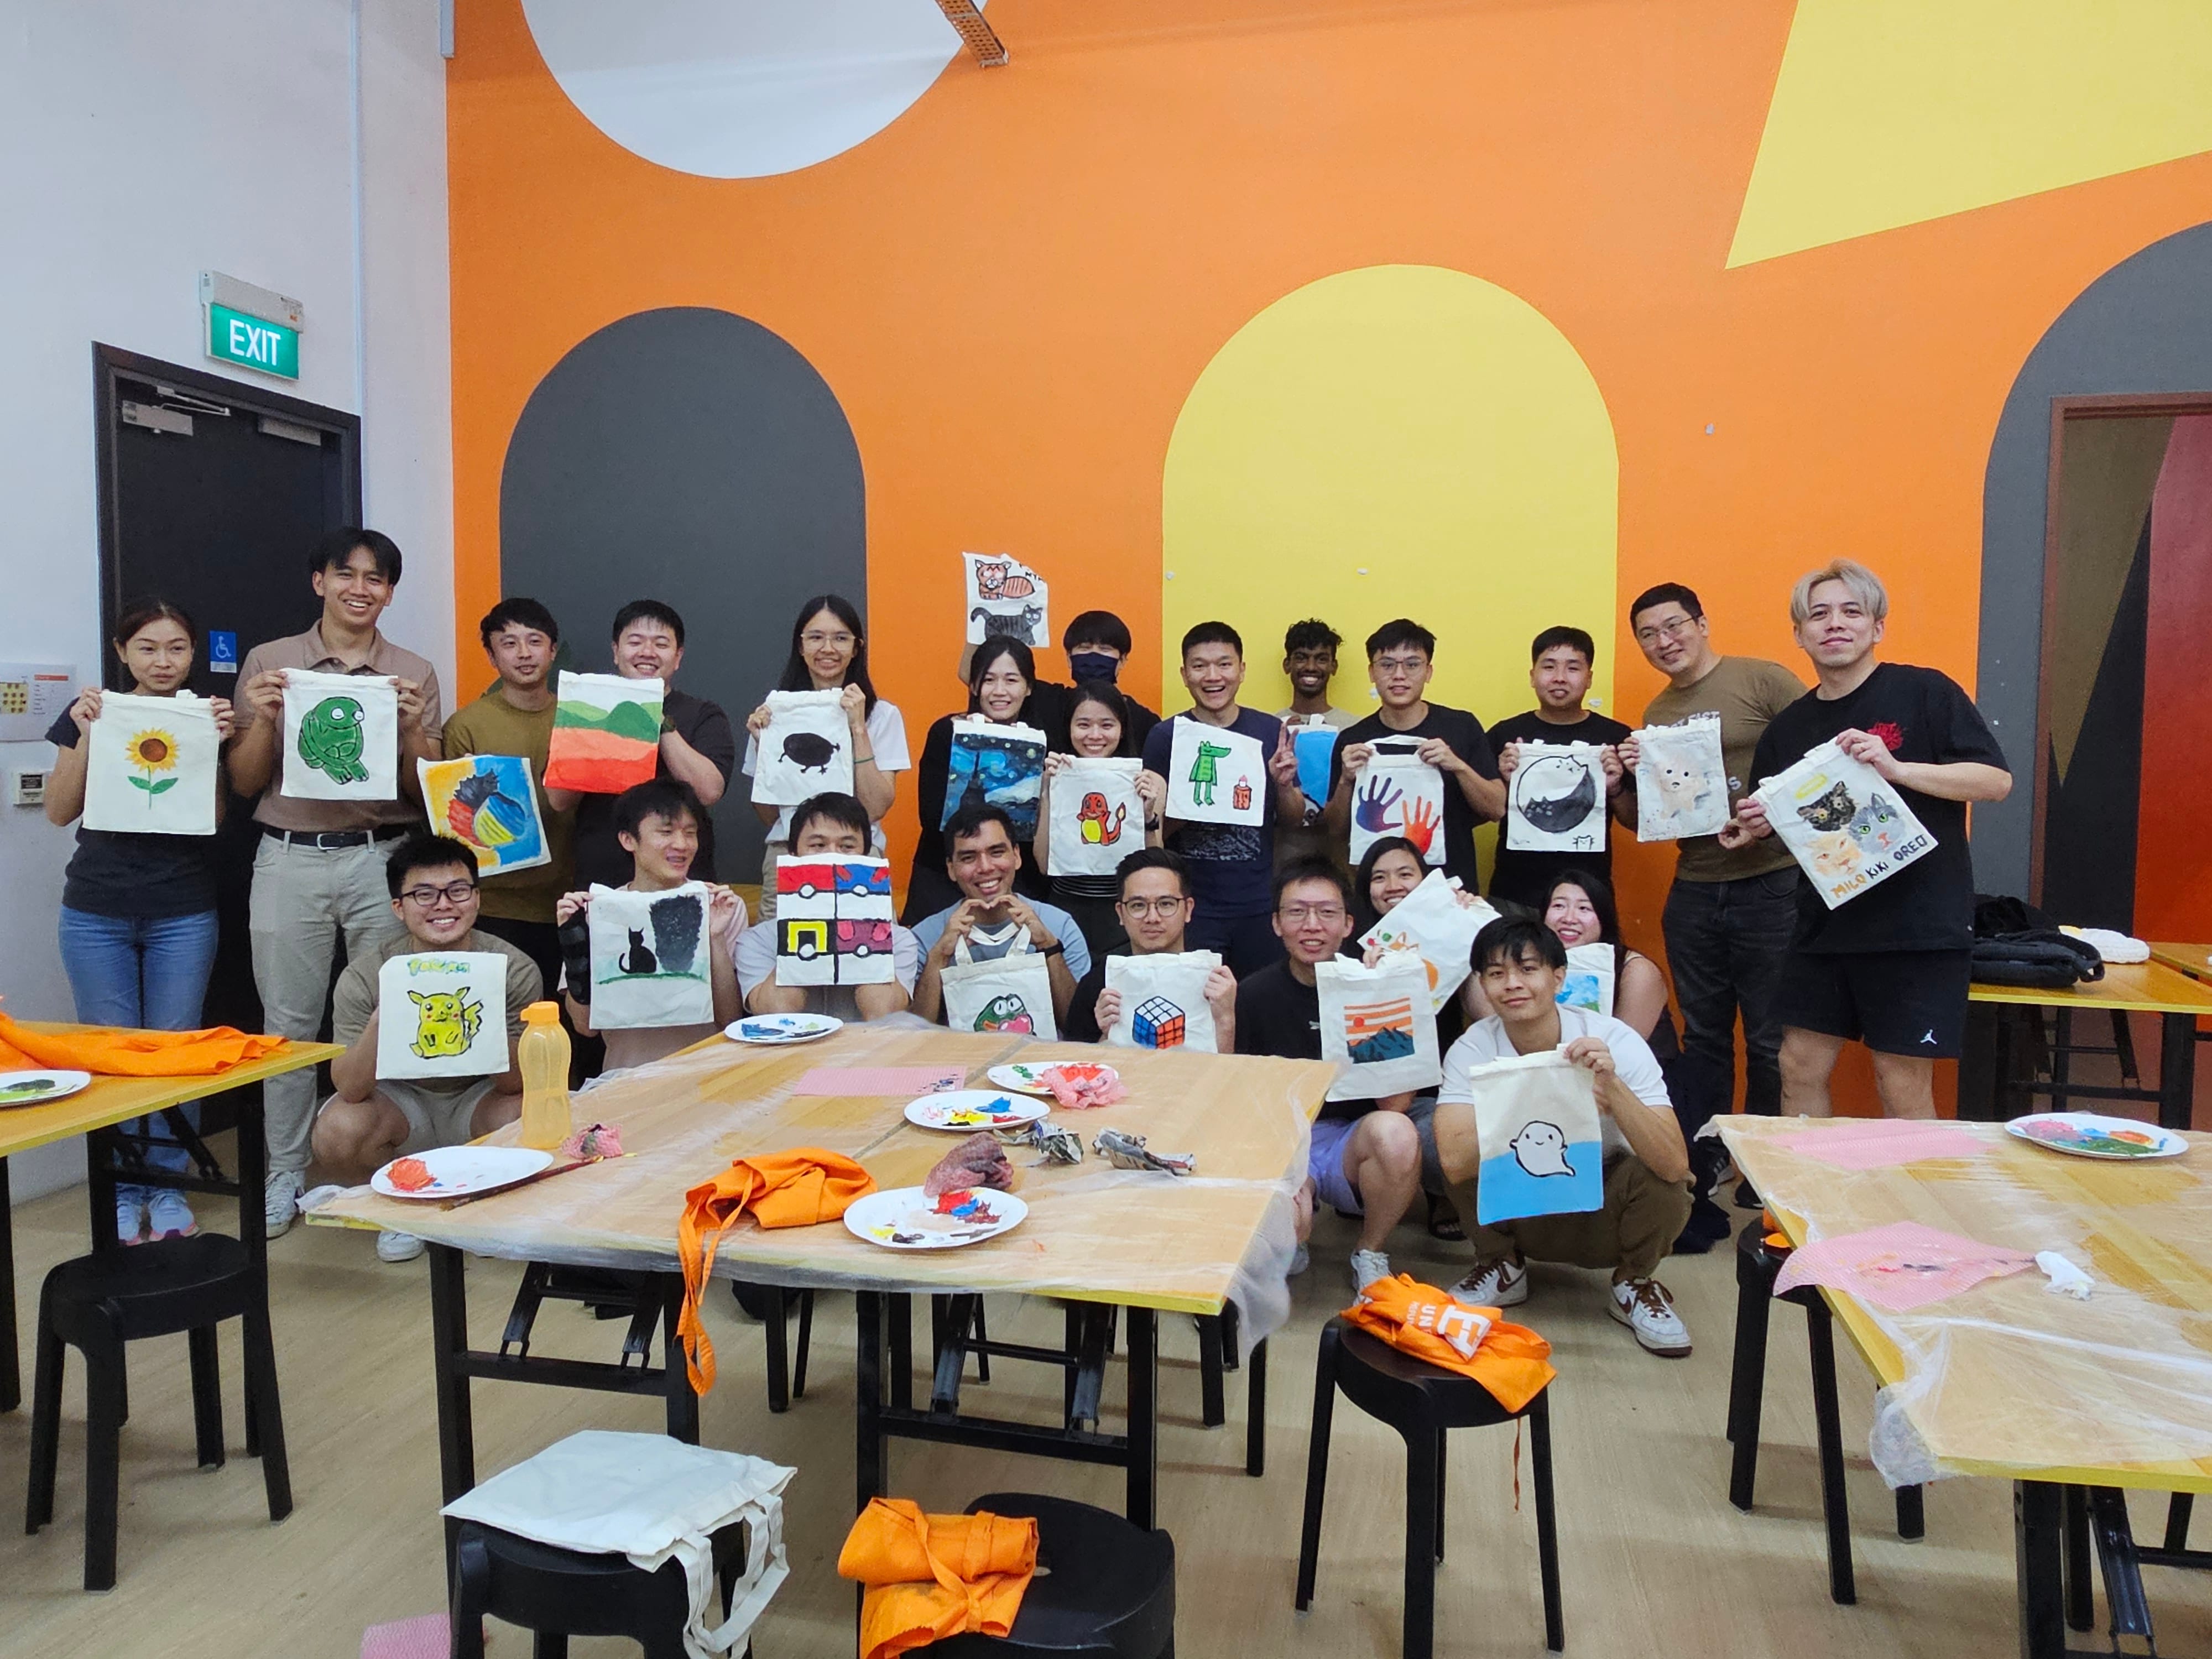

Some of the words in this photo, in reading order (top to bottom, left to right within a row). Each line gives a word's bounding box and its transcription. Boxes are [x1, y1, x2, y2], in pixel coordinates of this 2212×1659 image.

[229, 318, 281, 366] EXIT
[1830, 873, 1867, 899] MILO
[1893, 834, 1928, 861] OREO
